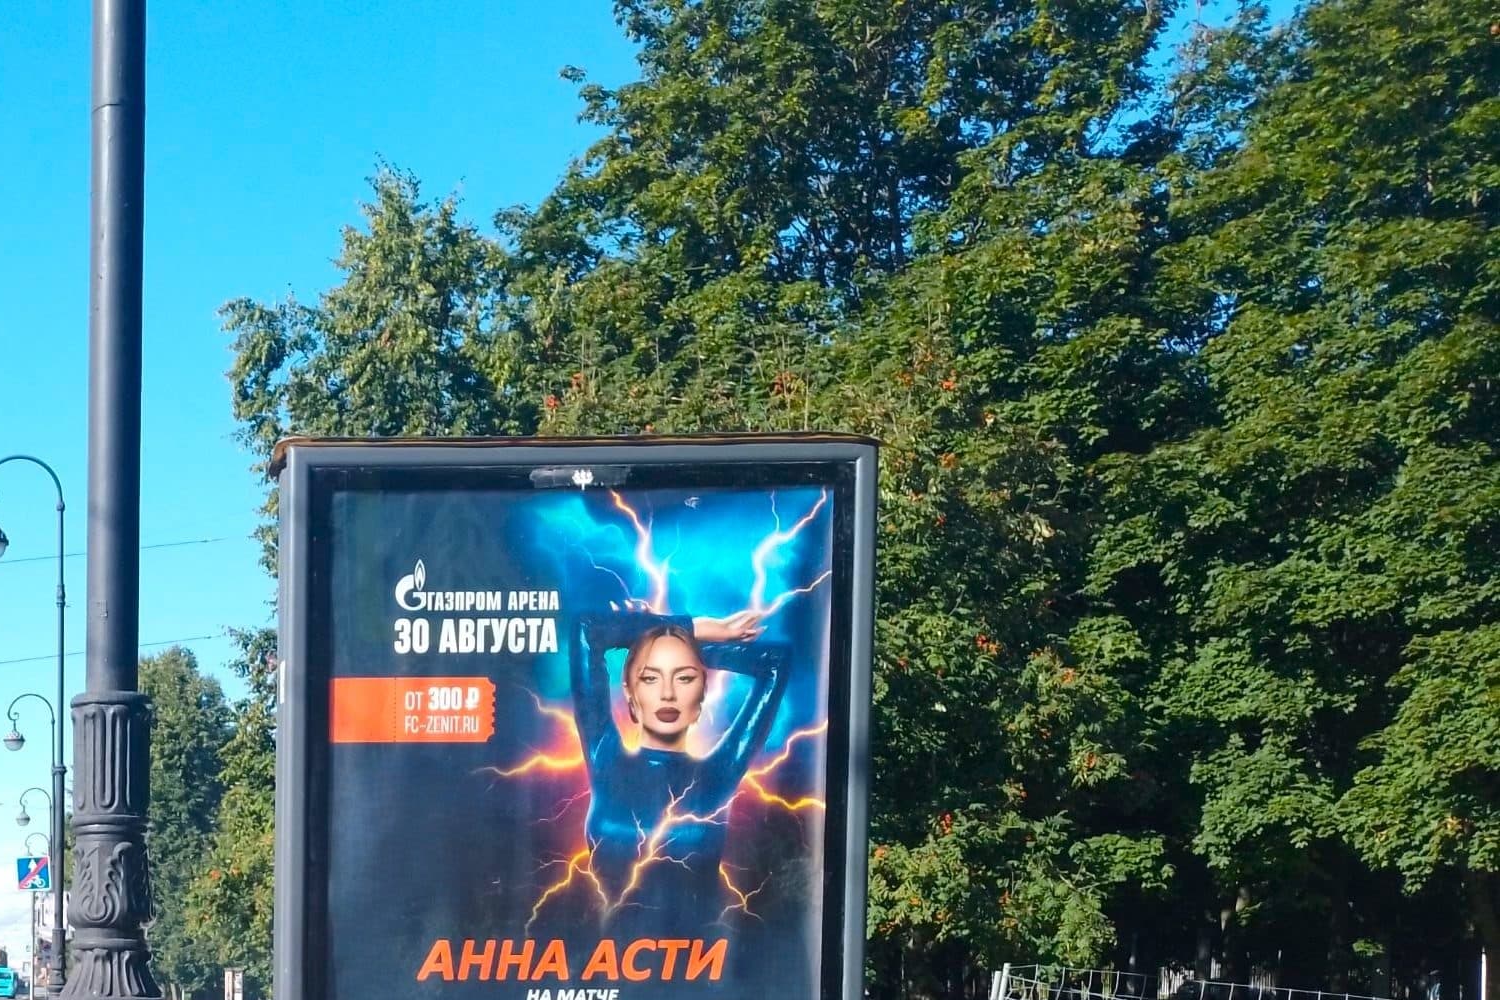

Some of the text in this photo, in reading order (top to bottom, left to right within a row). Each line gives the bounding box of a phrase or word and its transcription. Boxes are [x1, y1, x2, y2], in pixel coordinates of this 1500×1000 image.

[427, 591, 559, 611] ГАЗПРОМ АРЕНА
[394, 618, 558, 653] 30 АВГУСТА
[404, 691, 423, 711] ОТ
[428, 687, 463, 711] 300
[404, 715, 480, 734] FC-ZENIT.RU
[416, 938, 728, 981] АННА АСТИ
